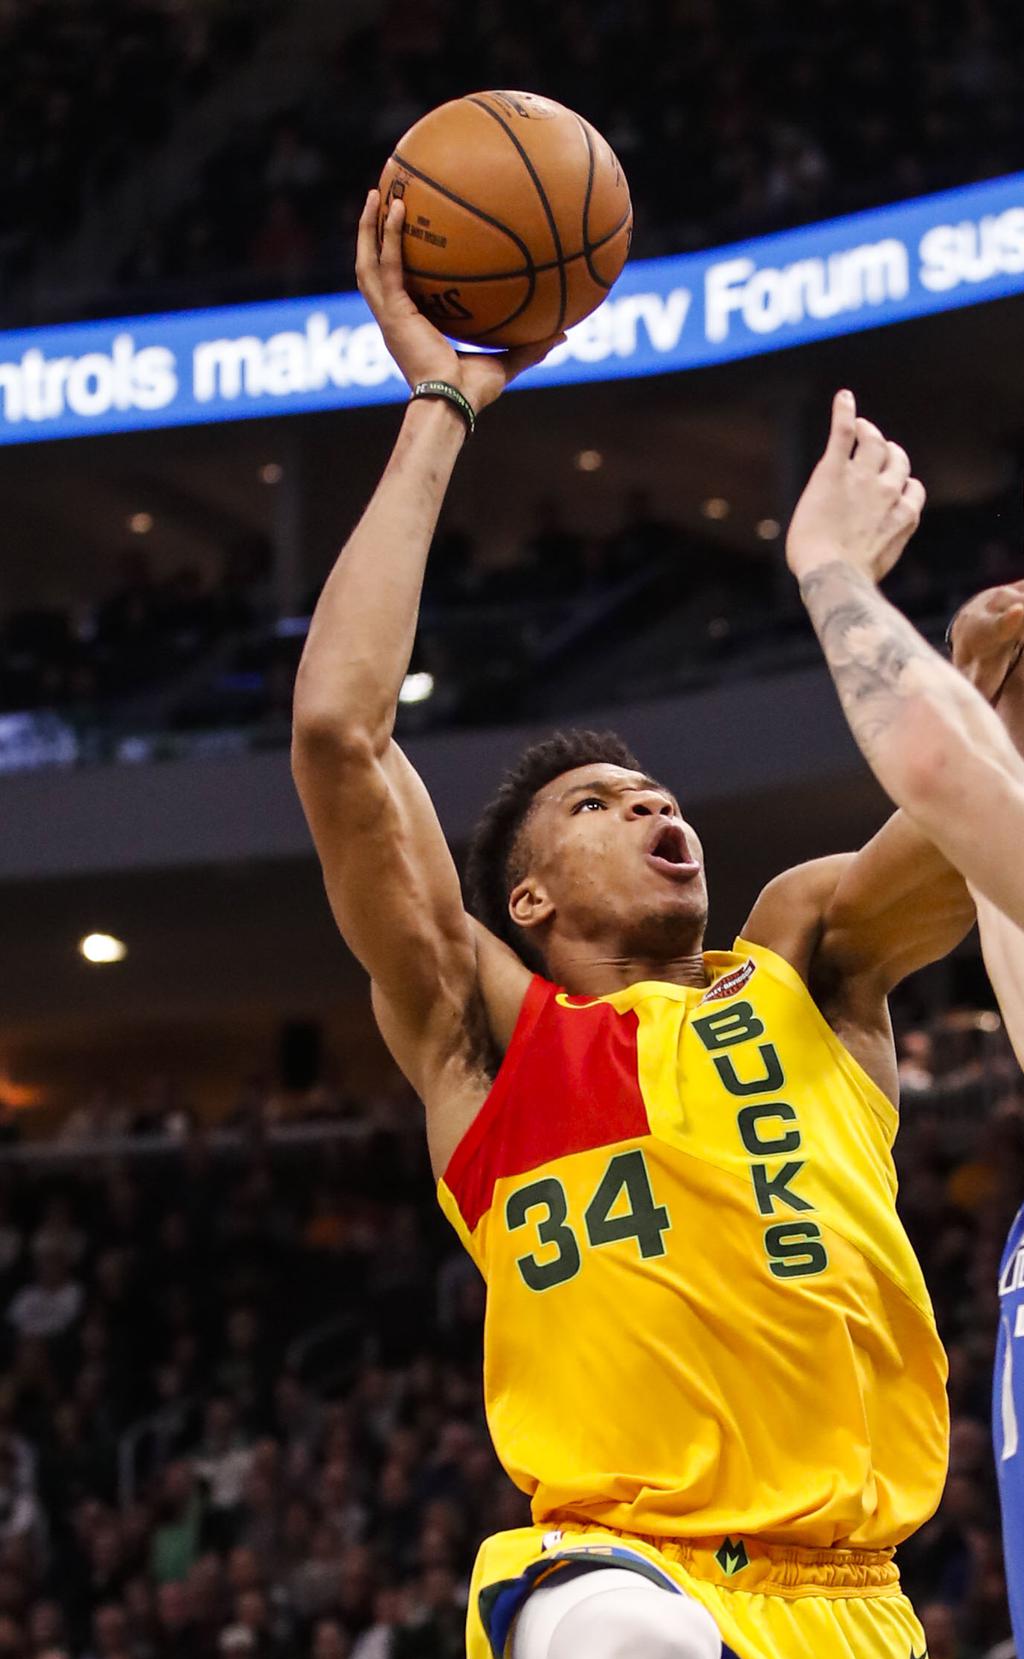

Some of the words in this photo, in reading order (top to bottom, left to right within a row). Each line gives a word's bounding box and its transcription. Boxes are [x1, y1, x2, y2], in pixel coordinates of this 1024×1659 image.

[704, 237, 909, 344] Forum
[691, 1000, 829, 1281] BUCKS
[504, 1147, 671, 1293] 34
